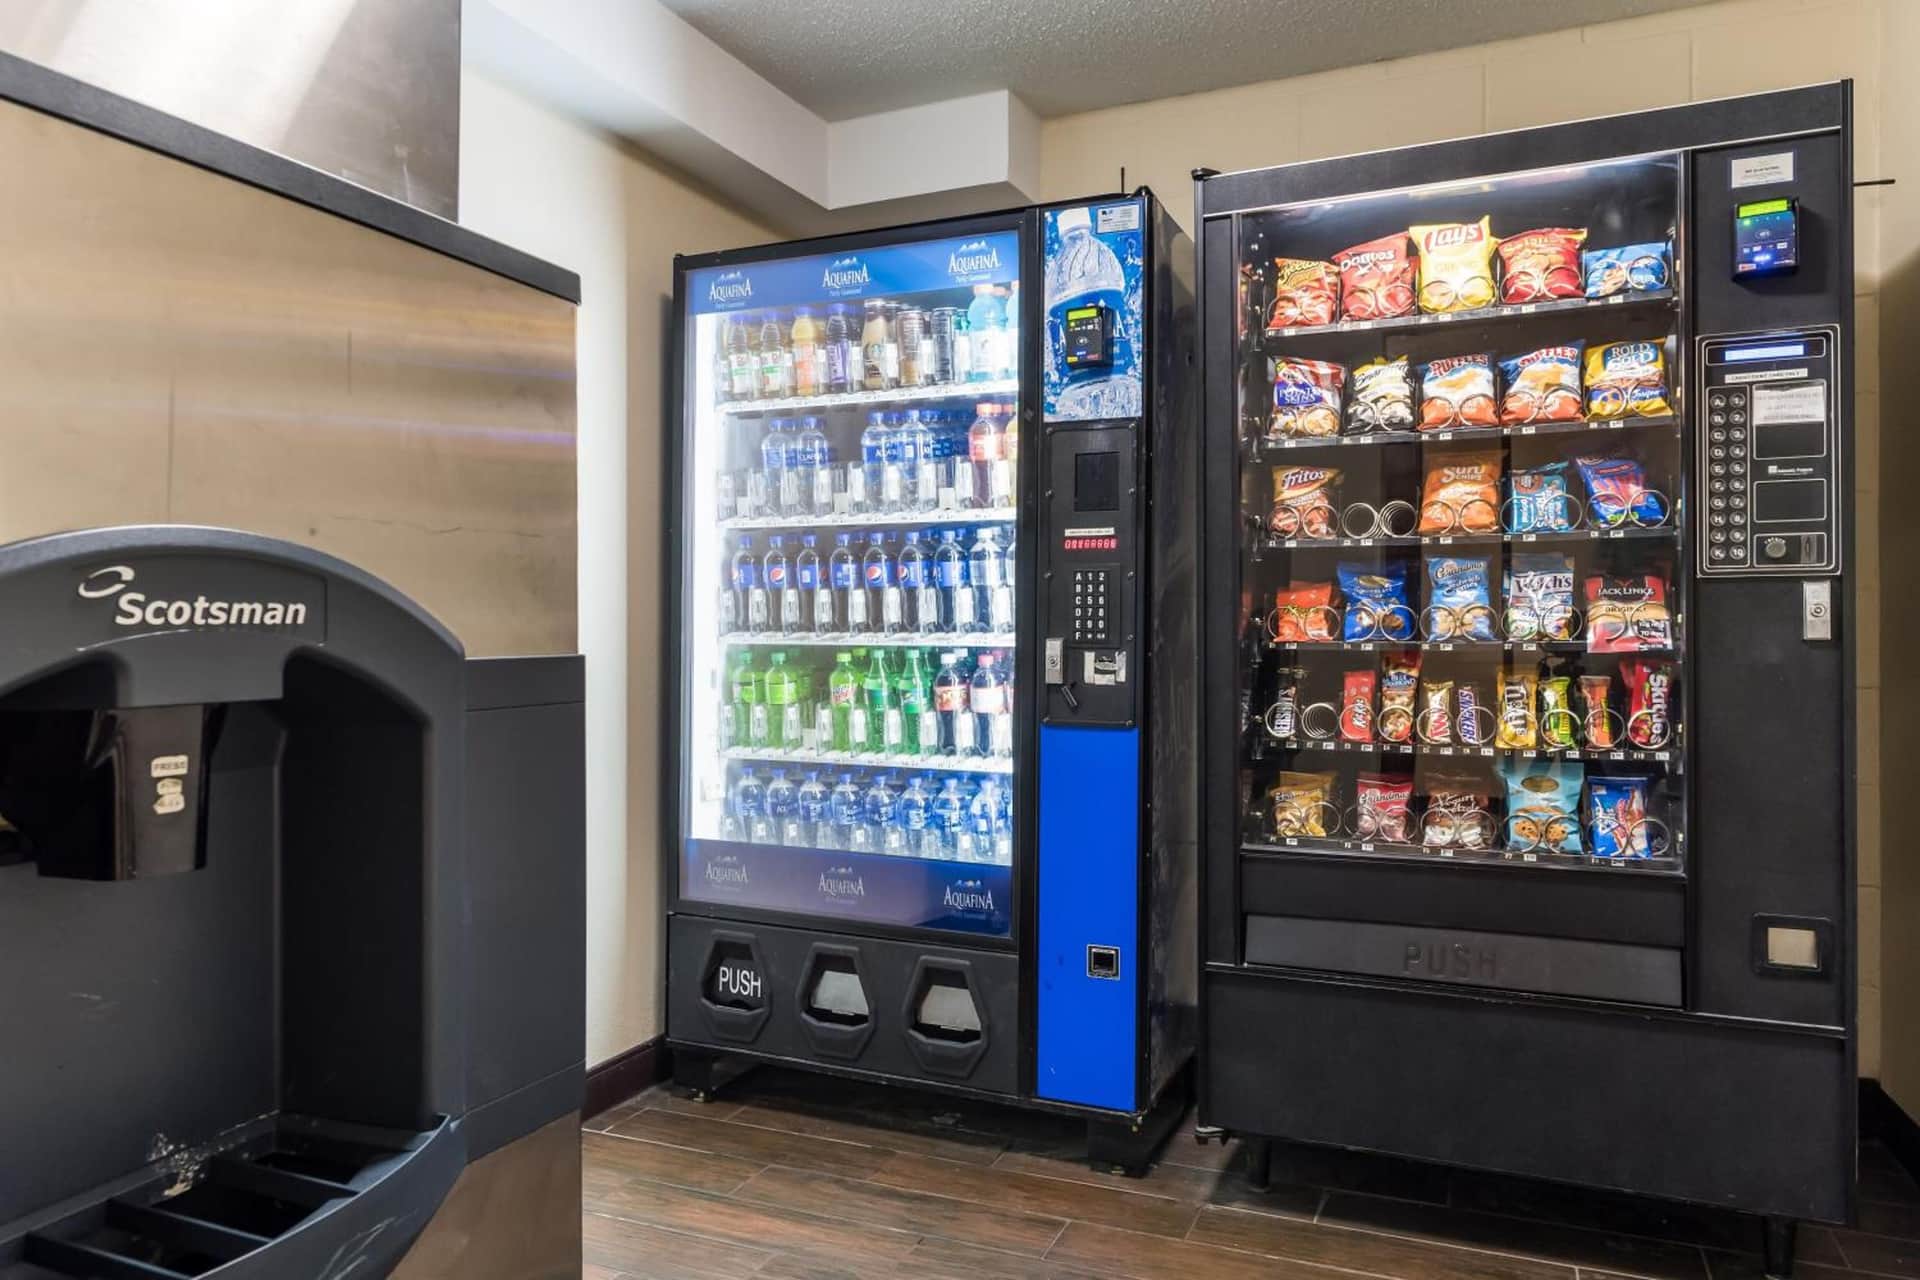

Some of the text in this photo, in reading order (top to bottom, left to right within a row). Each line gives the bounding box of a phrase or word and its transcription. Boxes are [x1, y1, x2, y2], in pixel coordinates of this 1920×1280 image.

[948, 247, 1001, 274] AQUAFINA
[822, 263, 871, 289] AQUAFINA
[709, 279, 753, 304] AQUAFINA
[1282, 470, 1325, 489] Fritos
[115, 592, 307, 626] Scotsman
[705, 866, 749, 884] AQUAFINA
[819, 874, 865, 898] AQUAFINA
[943, 885, 994, 911] AQUAFINA
[1403, 942, 1498, 980] PUSH
[719, 967, 762, 998] PUSH
